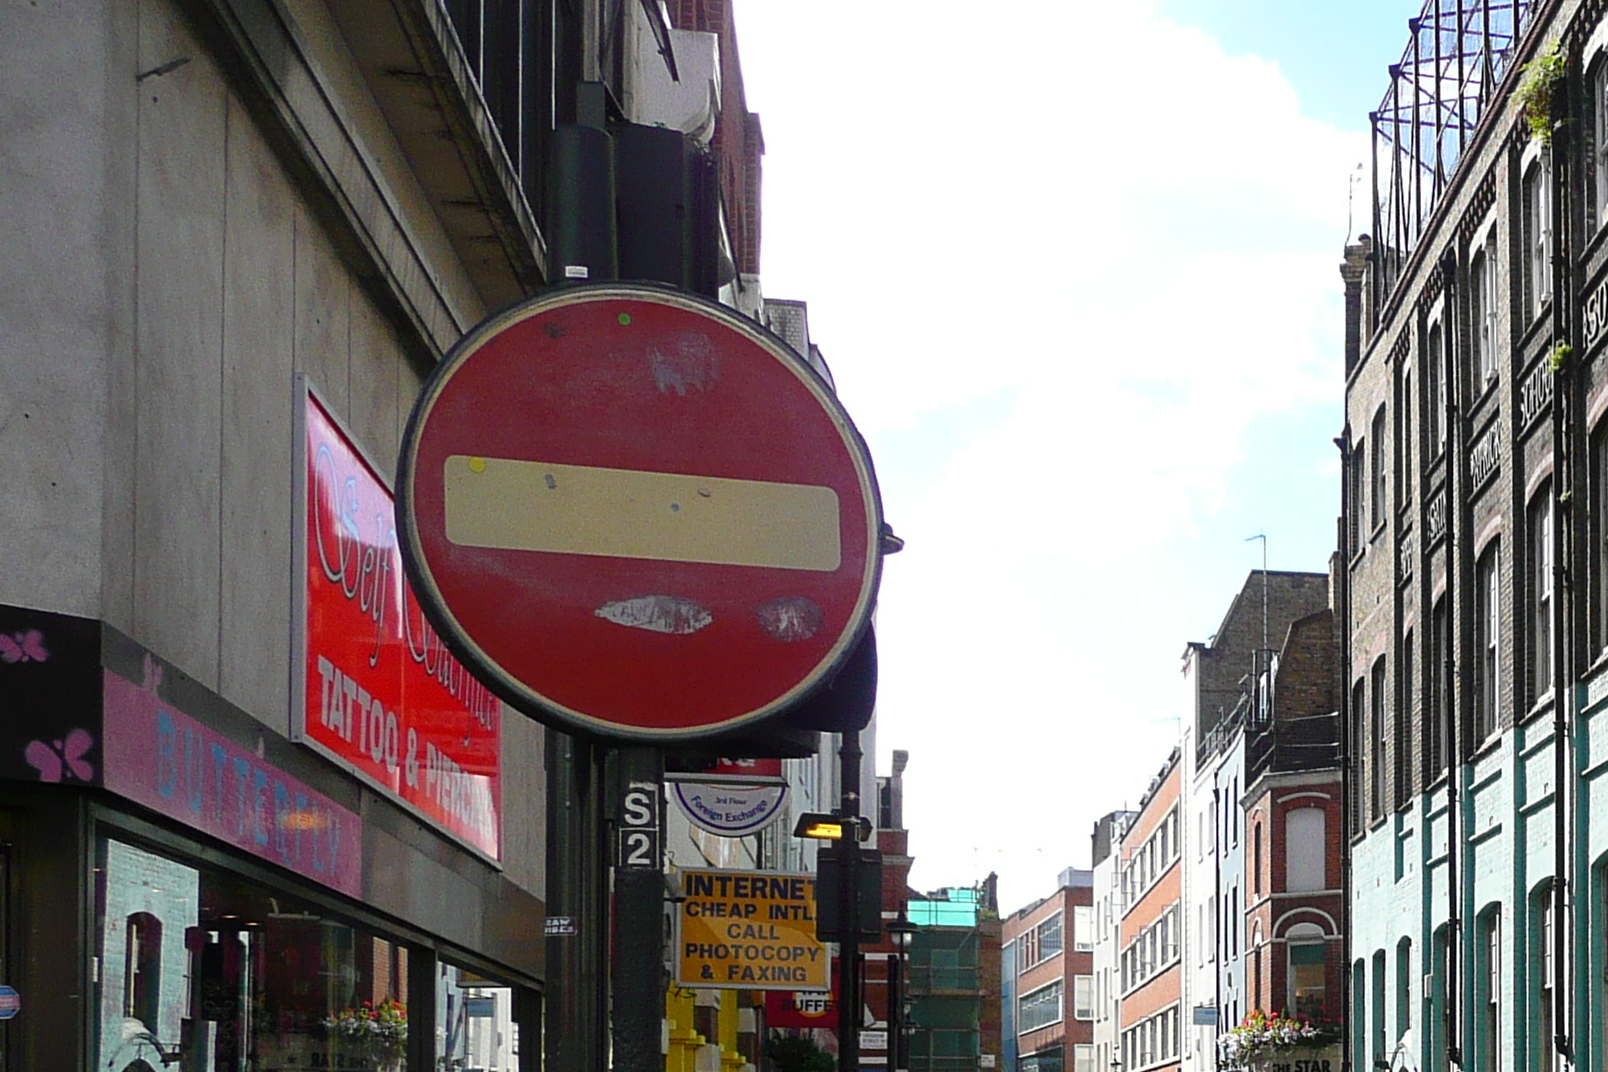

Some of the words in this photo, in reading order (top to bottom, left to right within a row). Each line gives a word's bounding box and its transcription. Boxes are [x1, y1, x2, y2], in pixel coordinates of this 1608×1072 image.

[318, 654, 398, 774] TATTOO
[405, 726, 419, 790] &
[157, 708, 340, 878] BUTTERFLY
[624, 792, 651, 826] S
[691, 795, 723, 820] Foreign
[725, 799, 768, 822] Exchange
[627, 833, 651, 865] 2
[685, 901, 757, 919] CHEAP
[727, 923, 780, 941] CALL
[685, 942, 820, 962] PHOTOCOPY
[701, 964, 713, 980] &
[728, 964, 807, 982] FAXING
[782, 998, 834, 1012] BUFFE
